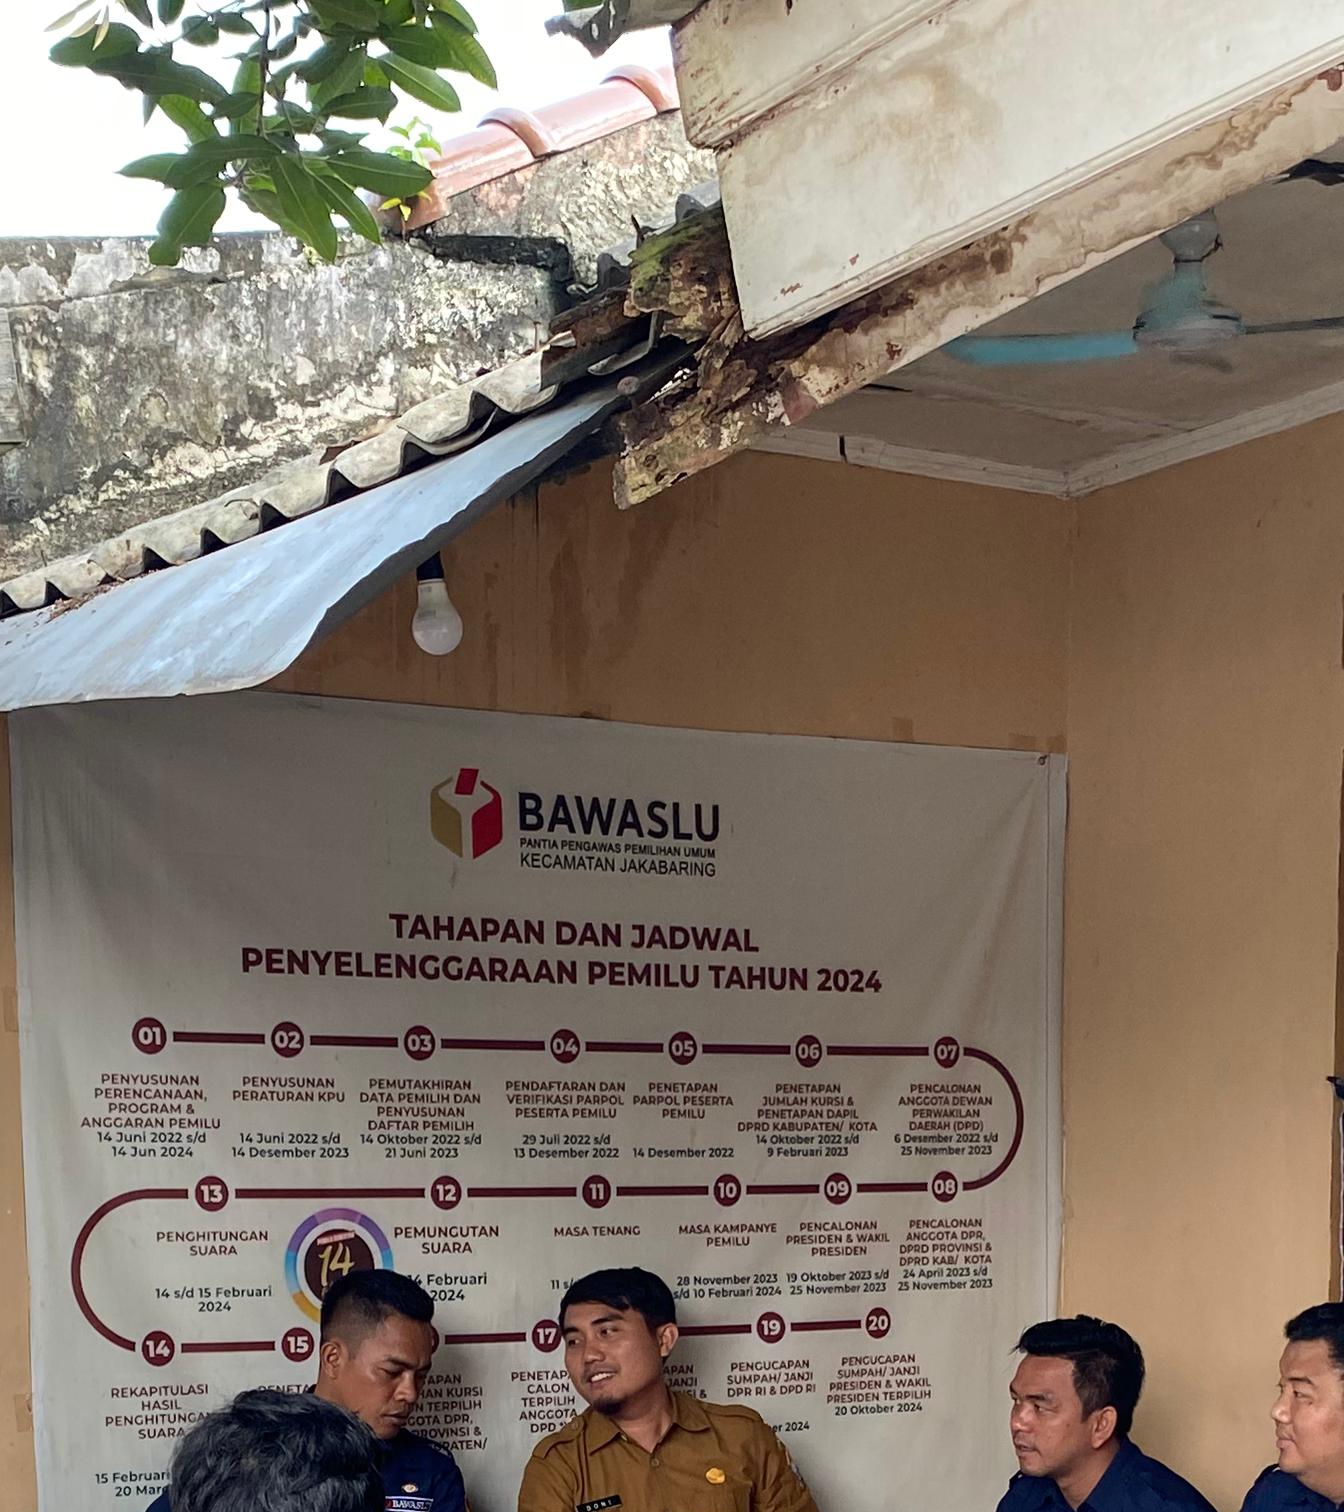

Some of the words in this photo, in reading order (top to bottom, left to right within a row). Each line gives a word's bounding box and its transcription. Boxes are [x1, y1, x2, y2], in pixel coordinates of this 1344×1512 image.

[518, 792, 719, 842] BAWASLU
[520, 837, 558, 850] PANTIA
[560, 839, 621, 854] PENGAWAS
[624, 843, 680, 856] PEMILIHAN
[684, 846, 715, 858] UMUM
[517, 851, 614, 872] KECAMATAN
[619, 858, 715, 877] JAKABARING
[388, 913, 544, 944] TAHAPAN
[556, 920, 621, 947] DAN
[630, 924, 759, 952] JADWAL
[242, 947, 577, 984] PENYELENGGARAAN
[588, 961, 699, 988] PEMILU
[708, 965, 808, 991] TAHUN
[816, 968, 882, 993] 2024
[138, 1026, 162, 1046] 01
[274, 1032, 300, 1050] 02
[406, 1034, 432, 1052] 03
[552, 1038, 578, 1056] 04
[670, 1040, 694, 1056] 05
[798, 1042, 820, 1060] 06
[936, 1044, 958, 1060] 07
[101, 1073, 199, 1086] PENYUSUNAN
[242, 1076, 334, 1088] PENYUSUNAN
[369, 1078, 471, 1091] PEMUTAKHIRAN
[505, 1080, 596, 1092] PENDAFTARAN
[599, 1081, 625, 1092] DAN
[648, 1082, 717, 1093] PENETAPAN
[775, 1083, 840, 1094] PENETAPAN
[910, 1083, 981, 1094] PENCALONAN
[232, 1090, 314, 1102] PERATURAN
[318, 1091, 344, 1102] KPU
[360, 1092, 394, 1103] DATA
[398, 1092, 449, 1104] PEMILIH
[453, 1093, 480, 1104] DAN
[506, 1094, 572, 1105] VERIFIKASI
[576, 1094, 624, 1105] PARPOL
[633, 1095, 680, 1106] PARPOL
[683, 1095, 734, 1106] PESERTA
[898, 1096, 950, 1106] ANGGOTA
[952, 1096, 992, 1106] DEWAN
[108, 1102, 181, 1114] PROGRAM
[186, 1103, 194, 1114] &
[377, 1106, 464, 1117] PENYUSUNAN
[515, 1107, 569, 1118] PESERTA
[572, 1107, 616, 1118] PEMILU
[662, 1108, 705, 1119] PEMILU
[757, 1108, 823, 1119] PENETAPAN
[826, 1108, 858, 1121] DAPIL
[80, 1117, 164, 1128] ANGGARAN
[169, 1117, 220, 1129] PEMILU
[368, 1120, 418, 1131] DAFTAR
[422, 1120, 474, 1131] PEMILIH
[908, 1120, 950, 1131] DAERAH
[953, 1120, 983, 1134] (DPD)
[97, 1131, 112, 1142] 14
[116, 1131, 146, 1142] Juni
[150, 1132, 182, 1143] 2022
[186, 1132, 206, 1144] s/d
[240, 1132, 253, 1143] 14
[256, 1132, 284, 1143] Juni
[288, 1133, 318, 1144] 2022
[322, 1133, 340, 1145] s/d
[360, 1134, 373, 1144] 14
[377, 1133, 428, 1144] Oktober
[432, 1134, 460, 1145] 2022
[464, 1133, 481, 1145] s/d
[522, 1134, 536, 1145] 29
[539, 1134, 560, 1144] Juli
[563, 1134, 590, 1145] 2022
[593, 1134, 610, 1148] s/d
[112, 1146, 126, 1156] 14
[130, 1146, 156, 1157] Jun
[160, 1146, 193, 1157] 2024
[232, 1146, 245, 1157] 14
[249, 1146, 316, 1158] Desember
[319, 1147, 349, 1158] 2023
[385, 1147, 396, 1158] 21
[400, 1147, 426, 1158] Juni
[430, 1147, 458, 1158] 2023
[513, 1148, 525, 1158] 13
[528, 1147, 589, 1158] Desember
[592, 1147, 619, 1158] 2022
[632, 1147, 644, 1158] 14
[648, 1147, 706, 1158] Desember
[708, 1147, 734, 1158] 2022
[200, 1184, 222, 1202] 13
[436, 1184, 456, 1202] 12
[588, 1183, 606, 1200] 11
[718, 1182, 736, 1198] 10
[826, 1180, 850, 1197] 09
[934, 1179, 956, 1194] 08
[678, 1224, 710, 1234] MASA
[714, 1223, 776, 1233] KAMPANYE
[800, 1220, 877, 1232] PENCALONAN
[909, 1218, 982, 1229] PENCALONAN
[156, 1230, 268, 1242] PENGHITUNGAN
[394, 1225, 498, 1238] PEMUNGUTAN
[554, 1226, 589, 1236] MASA
[592, 1225, 640, 1236] TENANG
[906, 1230, 958, 1241] ANGGOTA
[706, 1236, 750, 1247] PEMILU
[786, 1234, 842, 1244] PRESIDEN
[846, 1233, 853, 1243] &
[856, 1233, 890, 1243] WAKIL
[190, 1245, 237, 1256] SUARA
[422, 1242, 472, 1254] SUARA
[427, 1272, 486, 1285] Februari
[155, 1288, 170, 1298] 14
[174, 1286, 194, 1299] s/d
[198, 1287, 211, 1298] 15
[216, 1285, 271, 1297] Februari
[198, 1301, 231, 1312] 2024
[760, 1320, 780, 1336] 19
[868, 1315, 888, 1331] 20
[536, 1328, 558, 1344] 17
[146, 1340, 170, 1358] 14
[286, 1336, 308, 1354] 15
[730, 1359, 809, 1372] PENGUCAPAN
[841, 1354, 915, 1366] PENGUCAPAN
[837, 1366, 887, 1379] SUMPAH/
[889, 1365, 920, 1376] JANJI
[727, 1372, 781, 1387] SUMPAH/
[784, 1371, 813, 1382] JANJI
[829, 1380, 881, 1392] PRESIDEN
[884, 1379, 892, 1389] &
[895, 1377, 931, 1388] WAKIL
[111, 1384, 208, 1398] REKAPITULASI
[527, 1382, 569, 1394] CALON
[521, 1395, 575, 1407] TERPILIH
[826, 1392, 879, 1404] PRESIDEN
[882, 1389, 931, 1401] TERPILIH
[141, 1399, 182, 1411] HASIL
[519, 1408, 578, 1420] ANGGOTA
[785, 1421, 809, 1431] 2024
[587, 1498, 613, 1512] DONI
